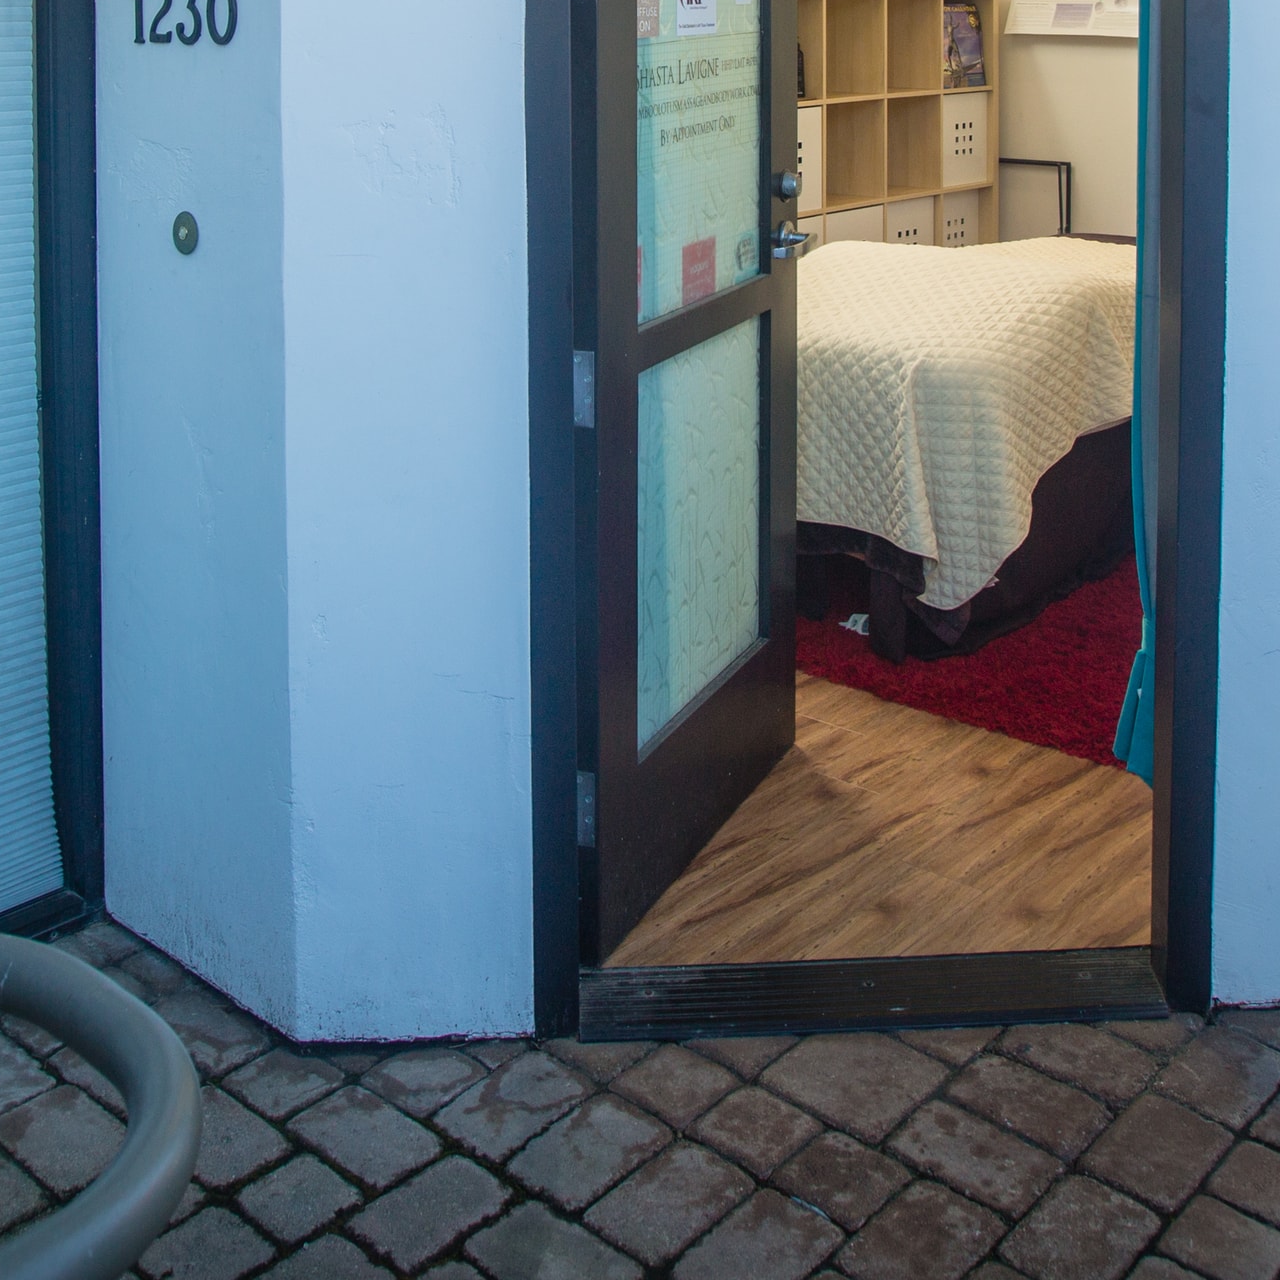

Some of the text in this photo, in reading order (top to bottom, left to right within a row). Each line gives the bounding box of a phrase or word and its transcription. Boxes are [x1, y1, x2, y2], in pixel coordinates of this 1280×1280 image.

[640, 20, 651, 32] ON
[636, 64, 675, 91] SHASTA
[678, 57, 720, 85] LAVIGNE
[660, 115, 737, 147] BY APPOINTMENT ONLY
